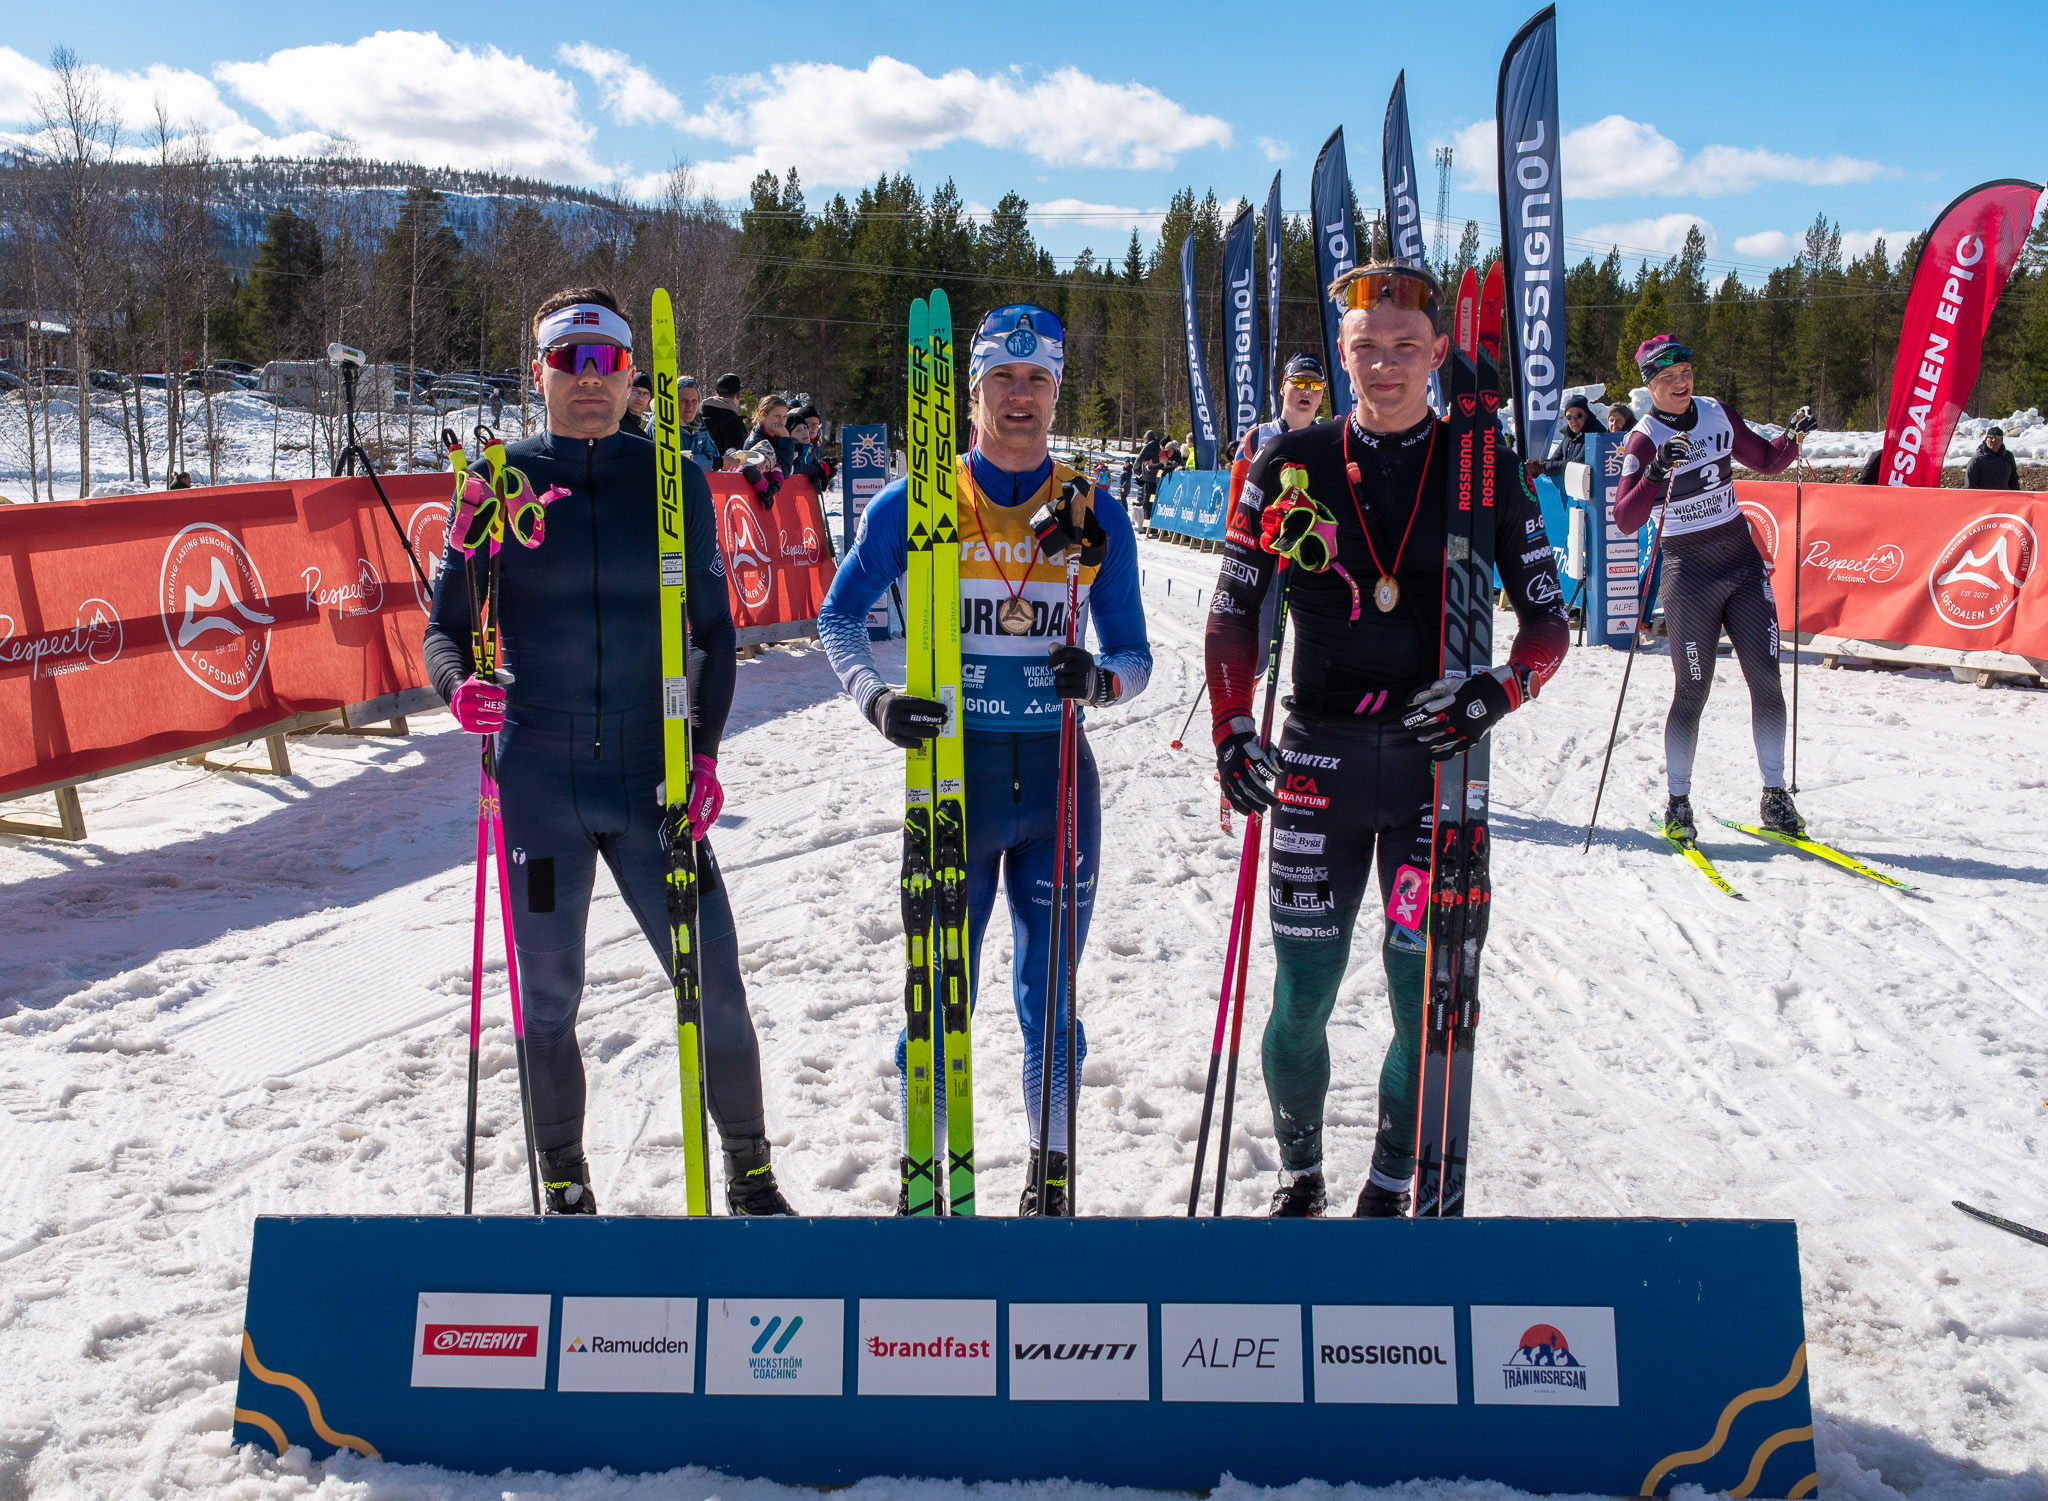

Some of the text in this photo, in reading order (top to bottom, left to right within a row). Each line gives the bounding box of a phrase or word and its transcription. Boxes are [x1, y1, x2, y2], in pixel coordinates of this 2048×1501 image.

[1516, 120, 1559, 421] ROSSIGNOL
[1888, 234, 1985, 488] FSDALEN EPIC
[912, 344, 929, 508] FISCHER
[933, 335, 953, 501] FISCHER
[657, 371, 679, 540] FISCHER
[1482, 426, 1495, 507] ROSSIGNOL
[1458, 429, 1473, 511] ROSSIGNOL
[1700, 463, 1722, 490] 3
[1673, 493, 1723, 516] WICKSTRÖM
[1680, 505, 1723, 523] COACHING
[1232, 511, 1250, 533] ICA
[1743, 508, 1767, 525] MEMORIES
[1226, 529, 1255, 547] VANTUM
[1942, 522, 2030, 572] CREATING LASTING MEMORIES TOGETHER
[1801, 540, 1878, 581] Respect
[169, 536, 260, 614] CREATING LASTING MEMORIES TOGETHER
[1940, 590, 2009, 620] LOFSDALEN EPIC
[1973, 591, 1990, 599] 2022
[1613, 603, 1634, 611] ALPE
[472, 632, 484, 679] LEKI
[485, 627, 496, 675] LEKI
[1268, 639, 1278, 685] LEKI
[47, 661, 89, 677] ROSSIGNOL
[190, 639, 261, 686] LOFSDALEN EPIC
[1028, 677, 1056, 687] COACH
[1281, 749, 1341, 770] TRIMTEX
[1285, 773, 1319, 794] ICA
[1278, 791, 1327, 807] KVANTUM
[1298, 837, 1321, 848] Bygg
[1295, 866, 1314, 874] Plåt
[1272, 920, 1339, 938] WOODTech
[458, 1332, 527, 1349] ENERVIT
[592, 1336, 688, 1354] Ramudden
[870, 1336, 990, 1358] brandfast
[1014, 1343, 1138, 1360] VAUHTI
[749, 1355, 803, 1369] WICKSTRÖM
[1181, 1337, 1290, 1368] ALPE
[1320, 1344, 1447, 1365] ROSSIGNOL
[753, 1368, 798, 1379] COACHING
[1503, 1367, 1587, 1391] TRÄNINGSRESAN
